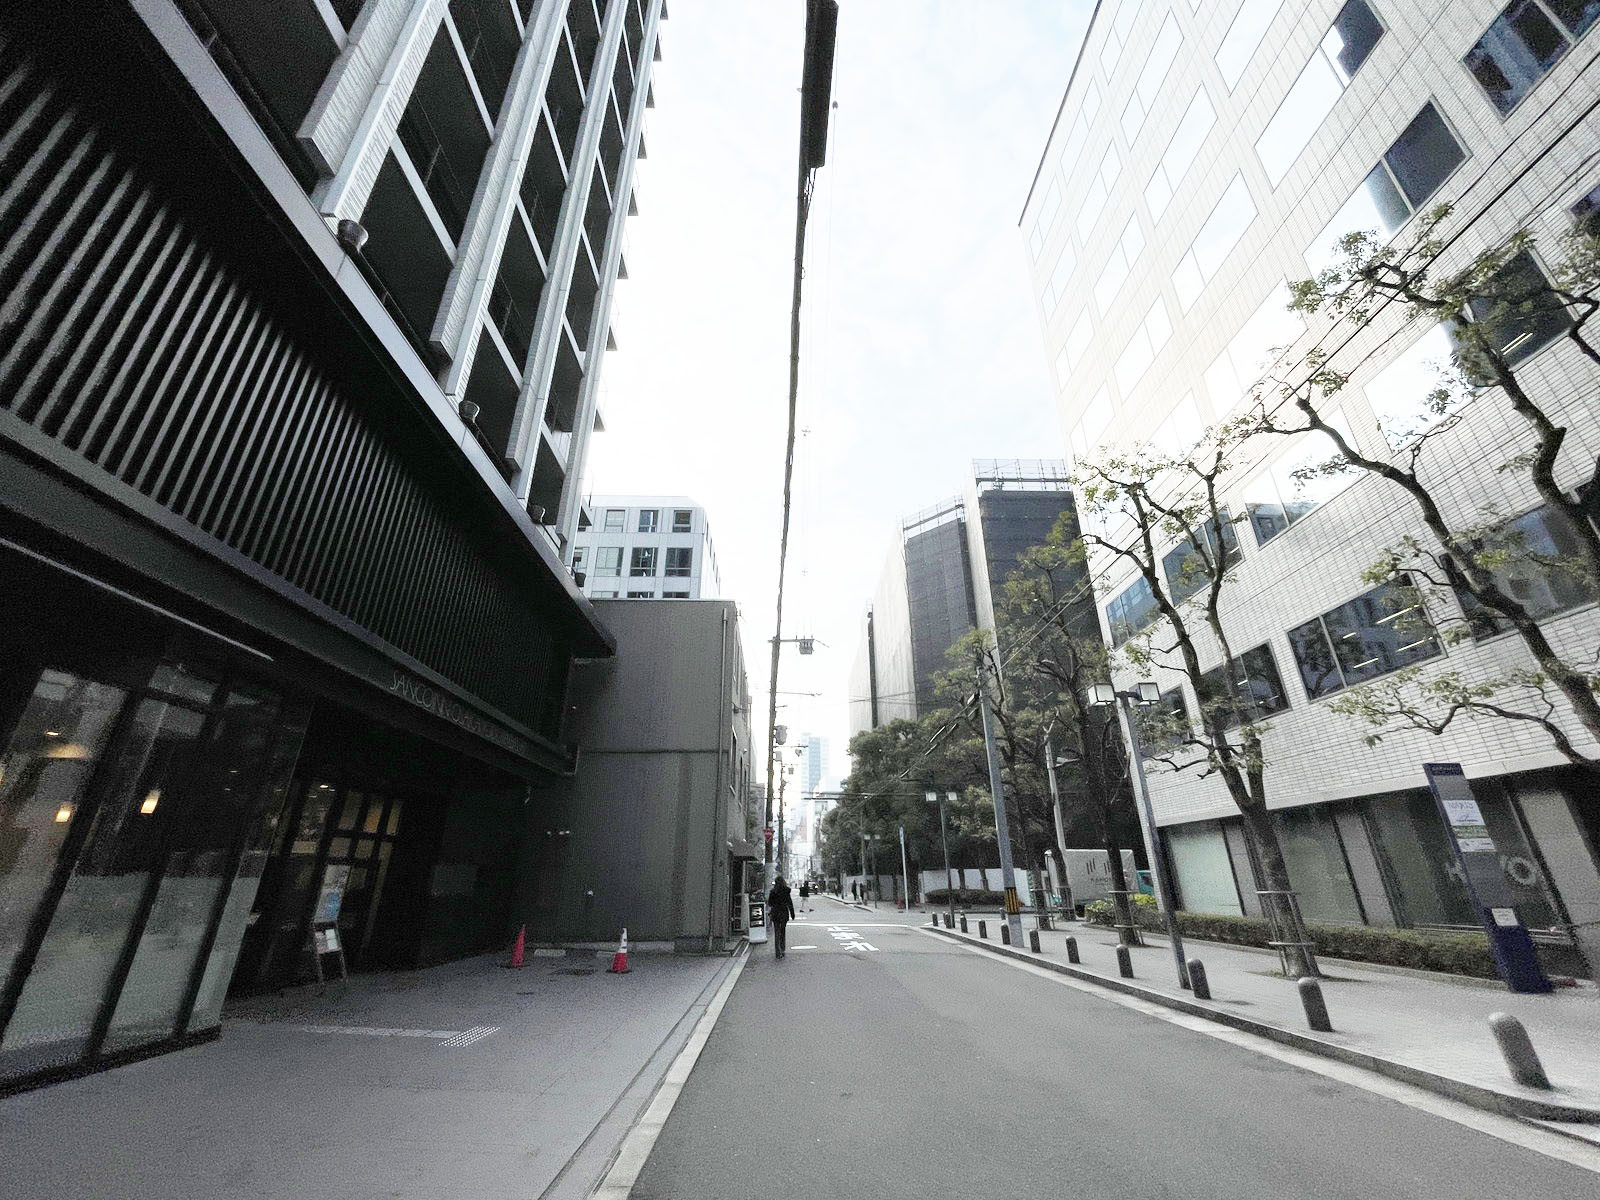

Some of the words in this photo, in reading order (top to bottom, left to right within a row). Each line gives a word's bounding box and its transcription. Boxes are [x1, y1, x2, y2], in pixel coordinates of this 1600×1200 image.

[389, 670, 433, 708] SANCO
[827, 925, 881, 952] 止まれ
